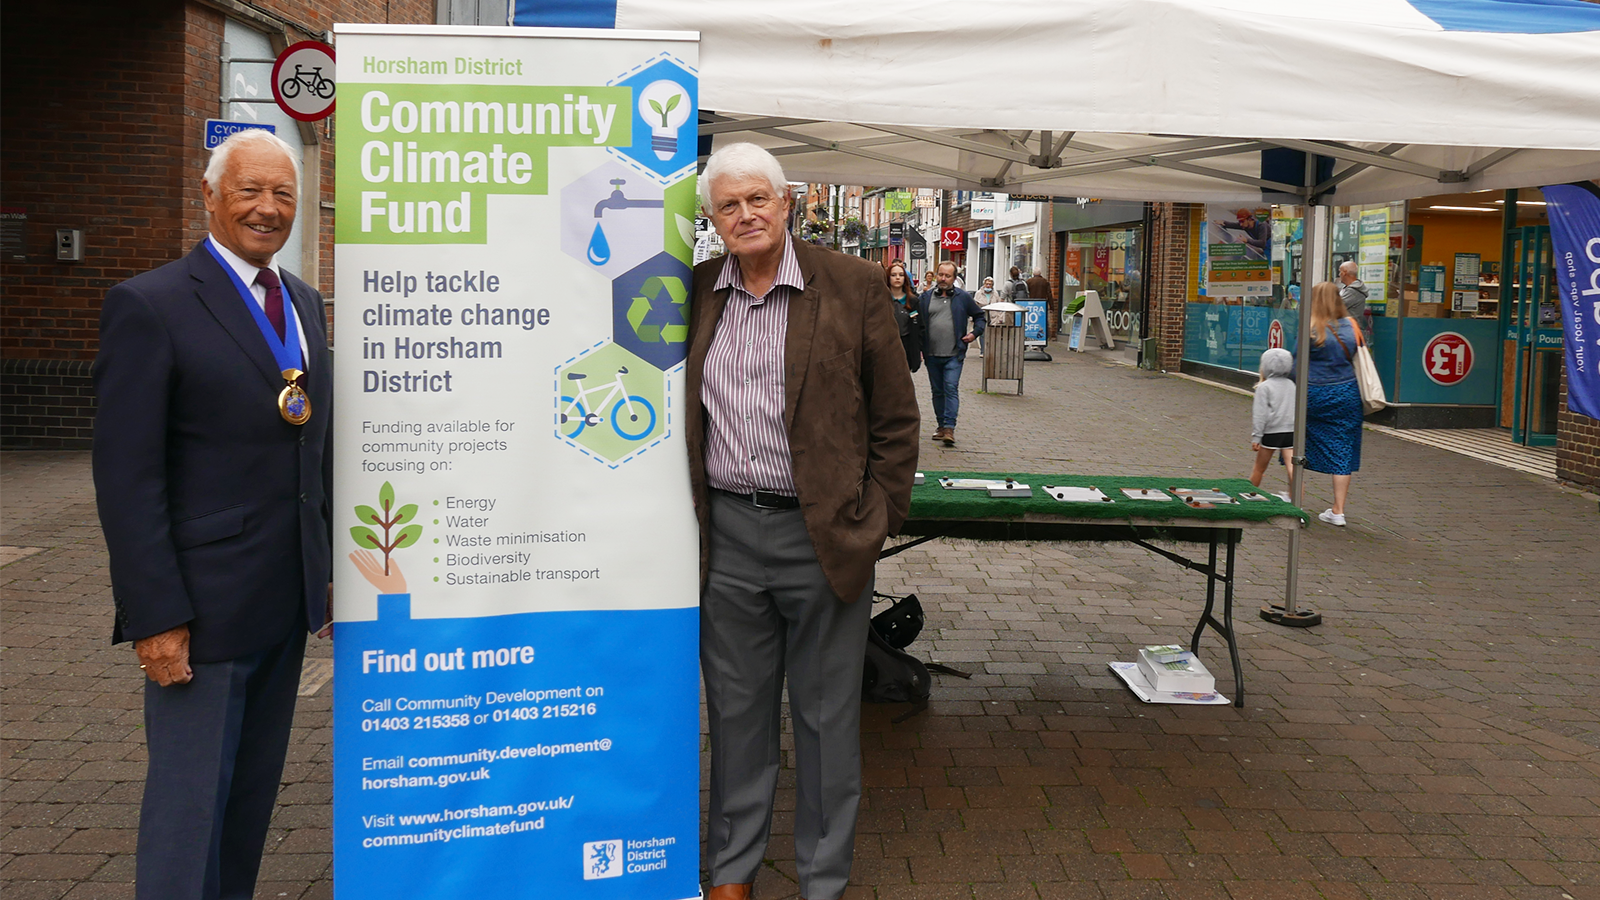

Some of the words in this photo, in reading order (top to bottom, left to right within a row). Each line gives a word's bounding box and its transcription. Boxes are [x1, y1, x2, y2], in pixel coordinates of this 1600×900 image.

[363, 56, 447, 75] Horsham
[455, 57, 522, 75] District
[360, 91, 616, 144] Community
[360, 141, 532, 184] Climate
[361, 191, 470, 233] Fund
[363, 270, 417, 297] Help
[425, 270, 500, 293] tackle
[363, 304, 453, 327] climate
[461, 303, 549, 331] change
[1106, 310, 1140, 331] FLOORS
[363, 337, 385, 360] in
[394, 336, 502, 360] Horsham
[1539, 334, 1564, 344] Poun
[1430, 343, 1464, 374] £1
[363, 370, 453, 393] District
[363, 421, 422, 435] Funding
[427, 420, 490, 433] available
[495, 420, 515, 432] for
[362, 440, 443, 455] community
[449, 438, 508, 454] projects
[362, 459, 425, 475] focusing
[430, 458, 452, 471] on:
[446, 496, 496, 512] Energy
[446, 515, 489, 528] Water
[446, 534, 492, 547] Waste
[496, 530, 586, 545] minimisation
[446, 551, 531, 566] Biodiversity
[446, 568, 531, 585] Sustainable
[535, 566, 600, 581] transport
[362, 648, 417, 674] Find
[424, 648, 465, 672] out
[472, 645, 535, 670] more
[362, 699, 392, 713] Call
[396, 694, 482, 712] Community
[486, 685, 582, 707] Development
[585, 686, 604, 698] on
[362, 717, 410, 732] 01403
[414, 714, 470, 729] 215358
[473, 711, 490, 725] or
[493, 707, 539, 723] 01403
[542, 703, 597, 719] 215216
[362, 756, 404, 771] Email
[408, 738, 612, 769] community.development@
[362, 767, 491, 790] horsham.gov.uk
[362, 814, 395, 829] Visit
[399, 796, 575, 826] www.horsham.gov.uk/
[362, 817, 545, 849] communityclimatefund
[627, 835, 676, 850] Horsham
[627, 847, 667, 860] District
[627, 859, 667, 874] Council
